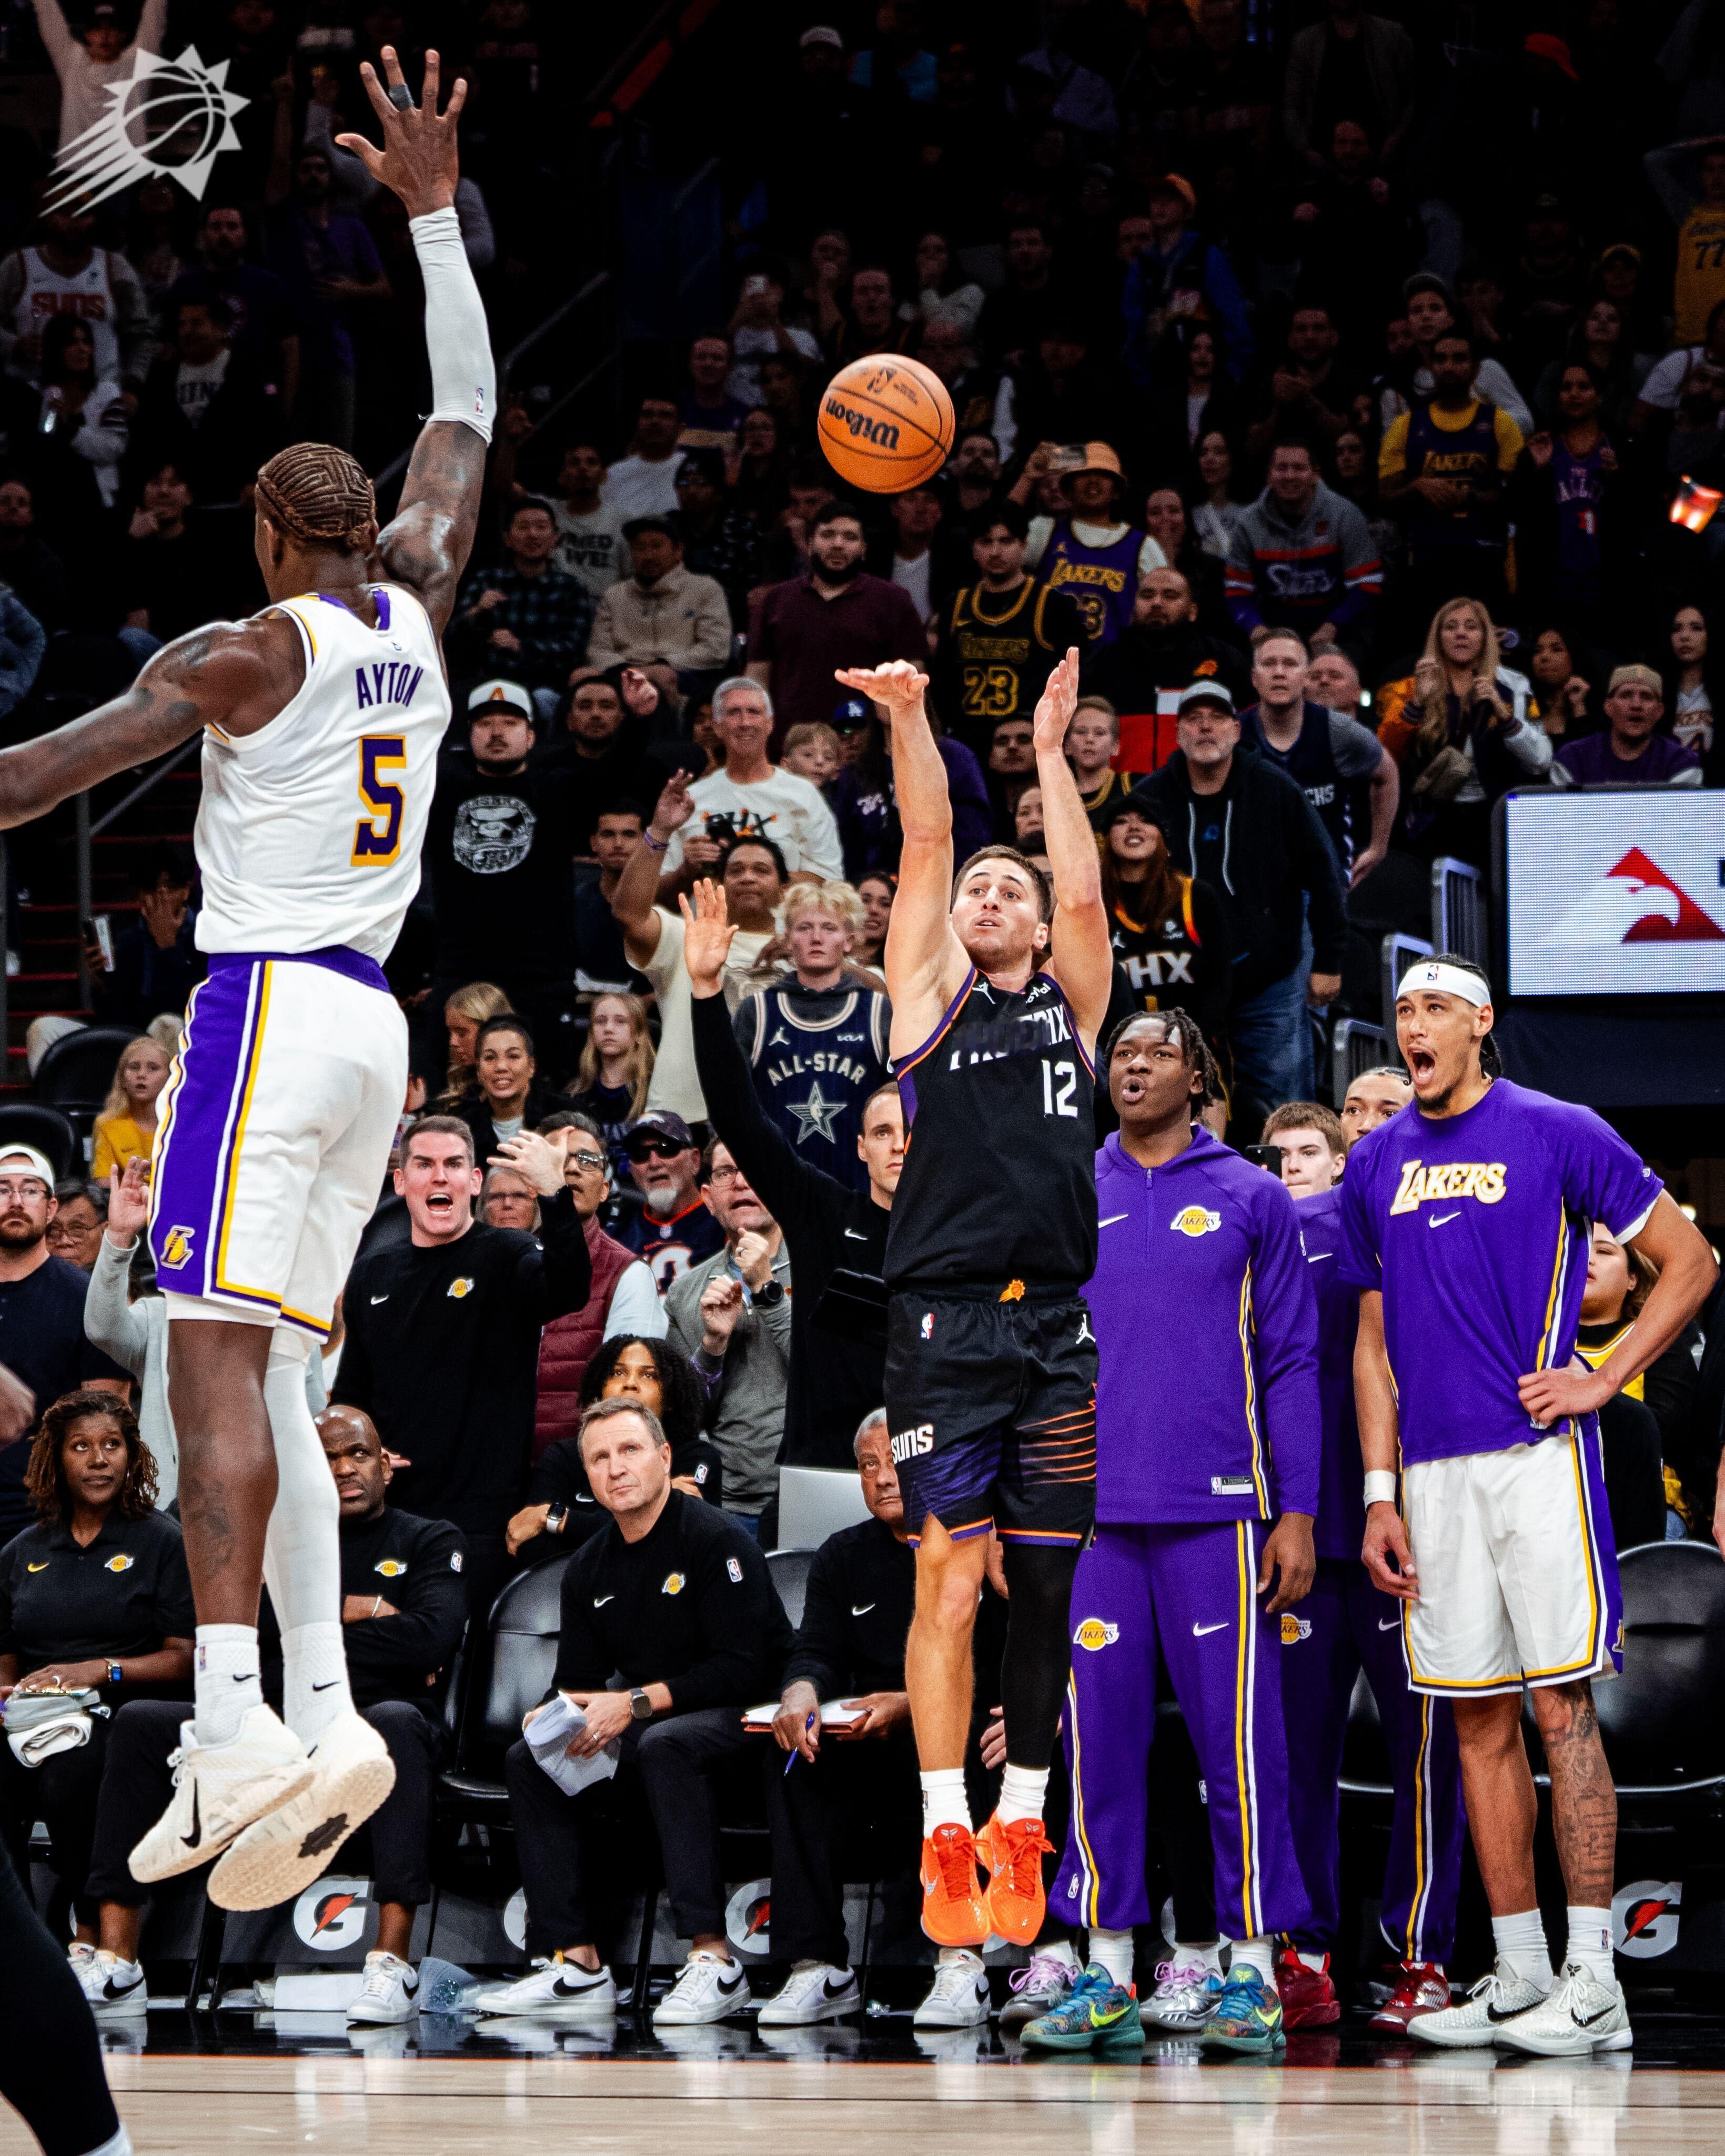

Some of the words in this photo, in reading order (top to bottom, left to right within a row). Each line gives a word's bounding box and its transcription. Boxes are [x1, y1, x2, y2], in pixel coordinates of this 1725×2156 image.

[1050, 556, 1128, 593] LAKERS
[356, 662, 423, 710] AYTON
[488, 687, 505, 701] A
[961, 664, 1020, 716] 23
[350, 734, 407, 866] 5
[1119, 951, 1195, 990] HX
[767, 1052, 865, 1087] ALL-STAR
[1041, 1059, 1078, 1119] 12
[1389, 1159, 1508, 1217] LAKERS
[891, 1423, 934, 1465] SUNS
[1282, 1625, 1312, 1638] KERS
[1611, 1880, 1683, 1959] G
